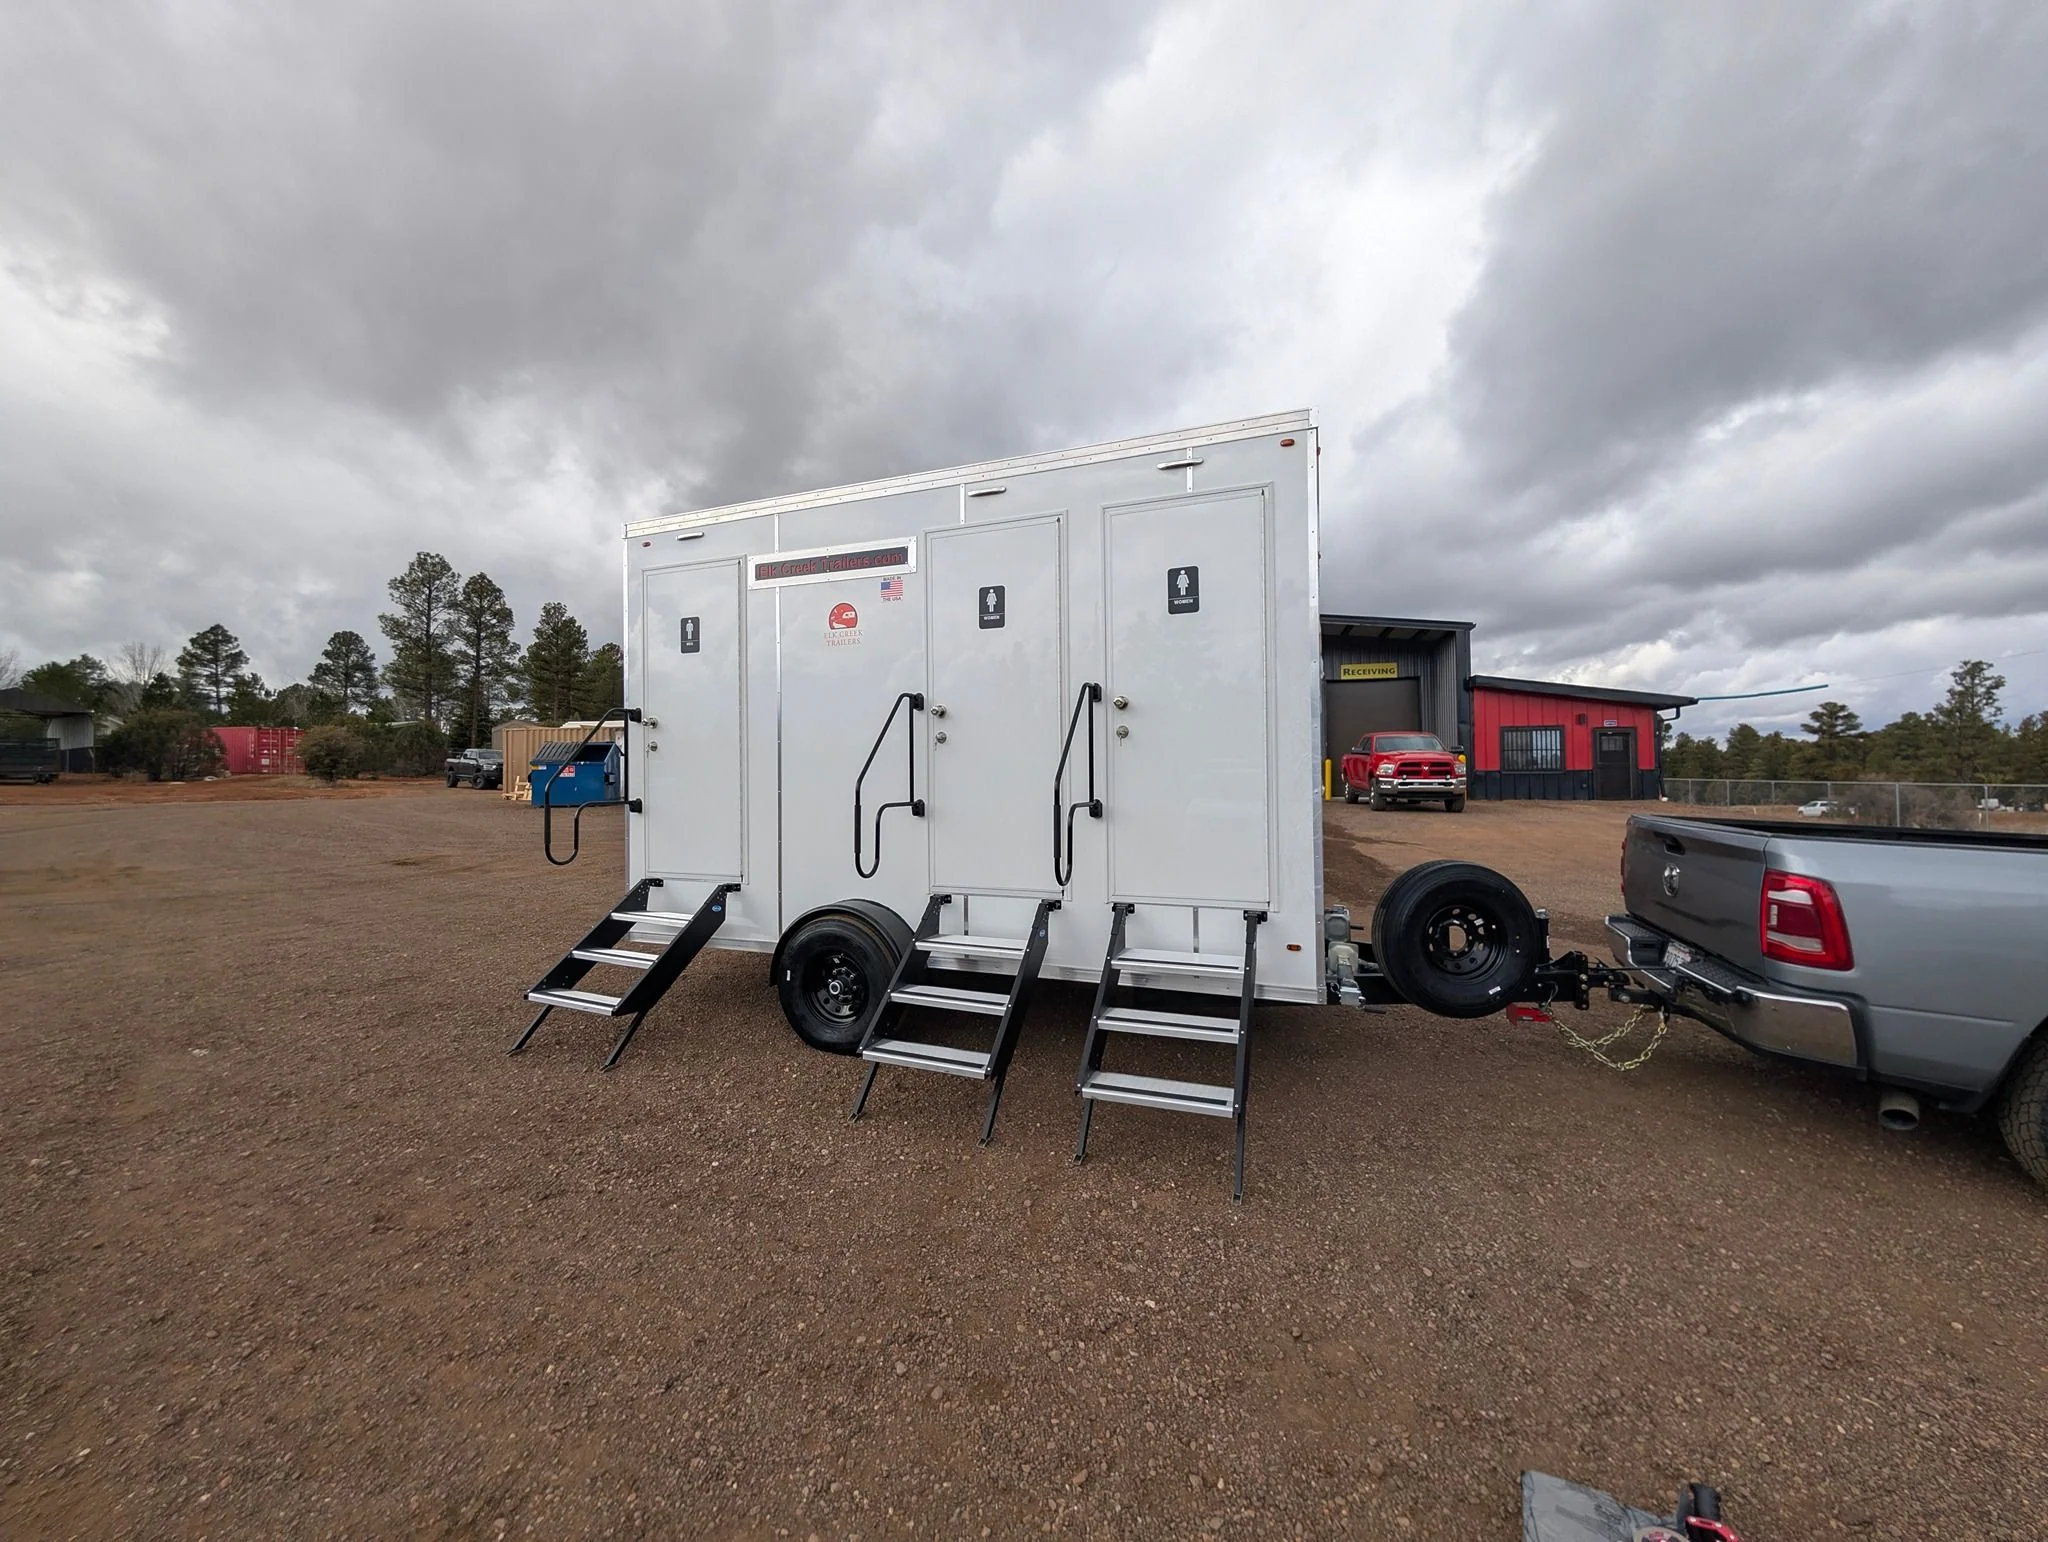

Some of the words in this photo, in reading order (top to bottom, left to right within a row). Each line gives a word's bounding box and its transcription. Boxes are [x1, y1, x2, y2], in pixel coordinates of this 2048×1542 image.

[781, 560, 818, 576] Creek
[824, 631, 838, 639] ELK
[839, 629, 863, 638] CREEK
[826, 638, 861, 647] TRAILERS
